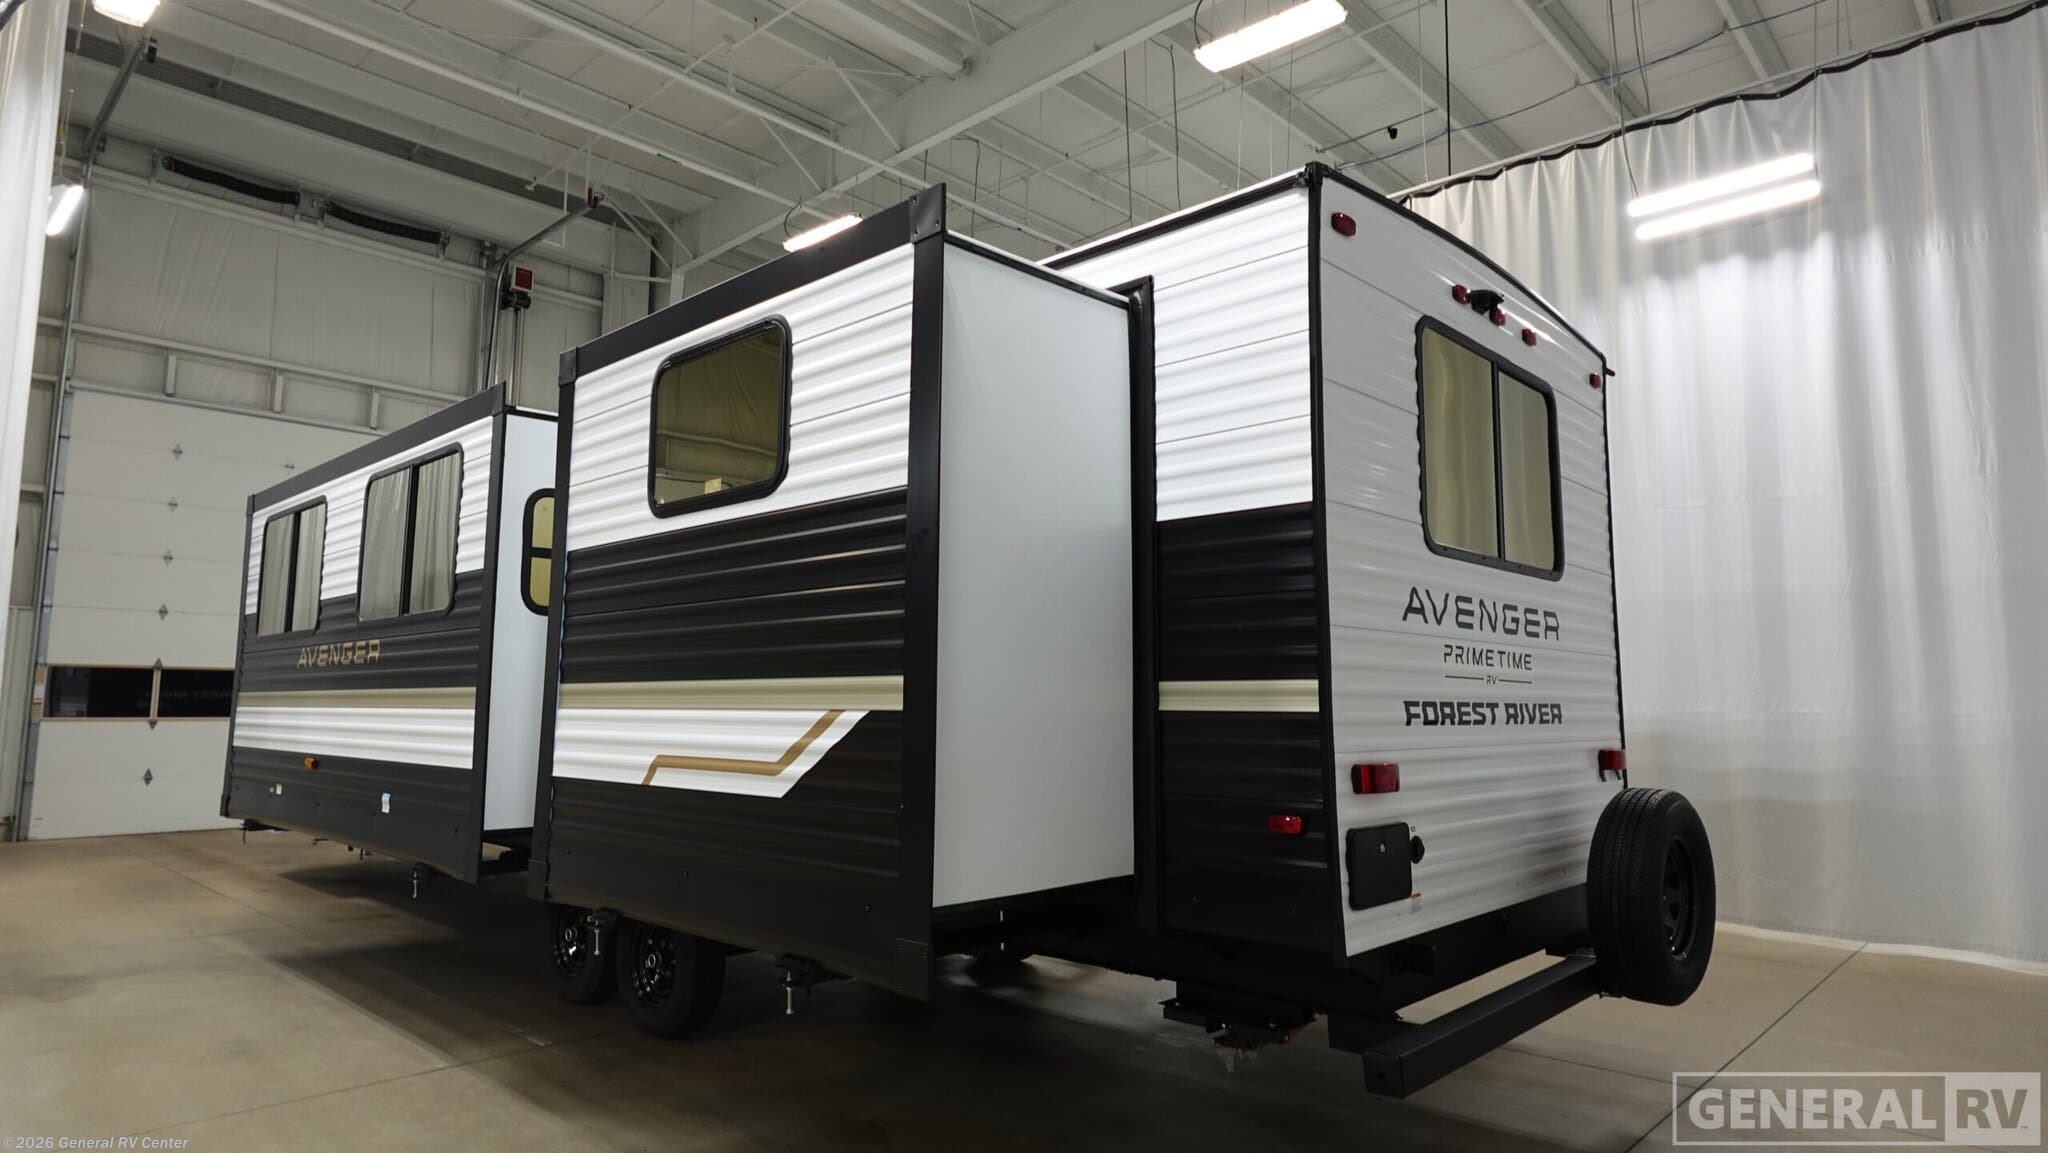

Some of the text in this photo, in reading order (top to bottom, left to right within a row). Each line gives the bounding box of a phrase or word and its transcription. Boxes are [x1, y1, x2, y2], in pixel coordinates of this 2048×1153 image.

[1402, 586, 1560, 641] AVENGER
[296, 639, 380, 668] AVENGER
[1443, 644, 1533, 670] PRIMETIME
[1486, 675, 1498, 685] RV
[1403, 700, 1563, 727] FOREST RIVER
